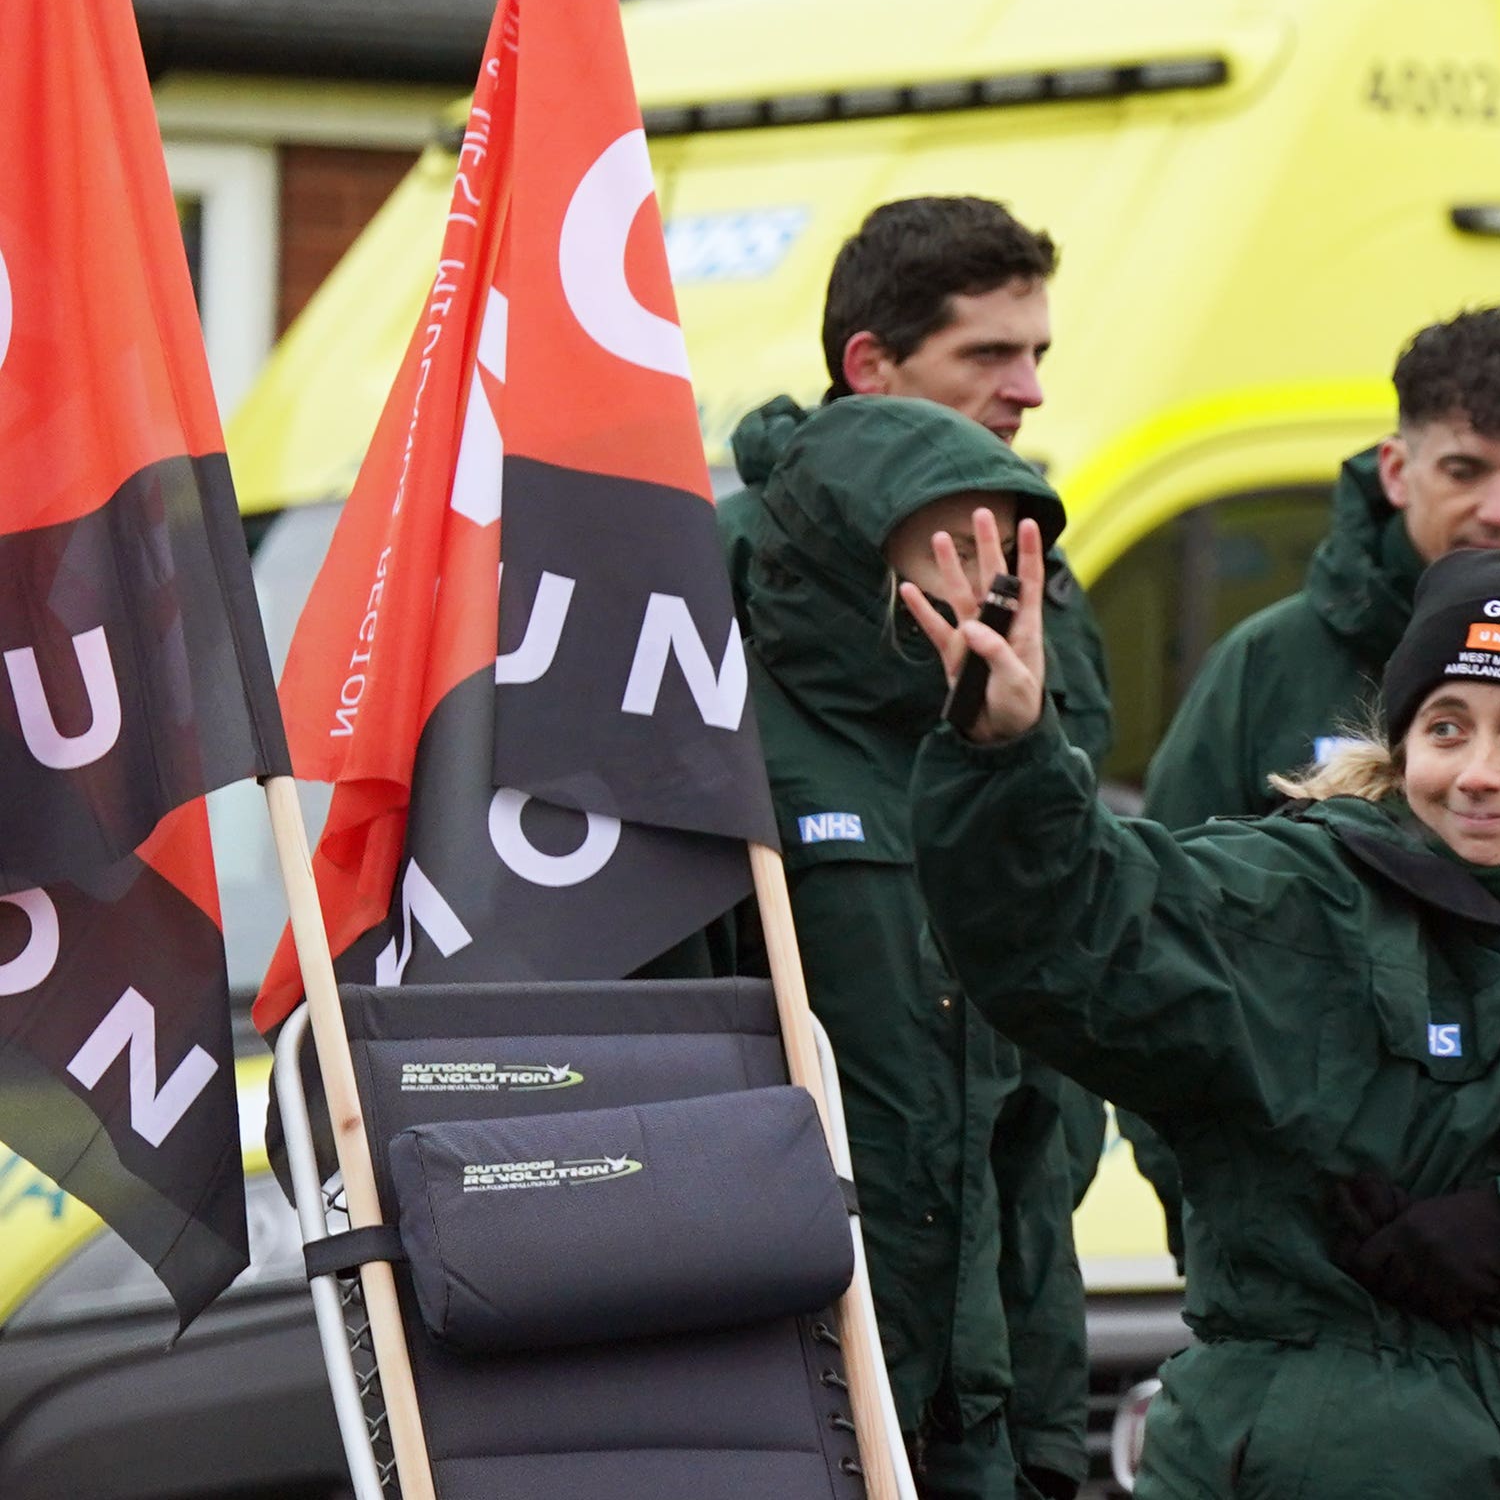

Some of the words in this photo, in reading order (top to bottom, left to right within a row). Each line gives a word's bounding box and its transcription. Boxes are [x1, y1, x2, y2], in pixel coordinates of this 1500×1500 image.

[1458, 651, 1492, 664] WEST
[804, 813, 861, 842] NHS
[402, 1062, 497, 1073] OUTDOOR
[401, 1072, 550, 1085] REVOLUTION
[463, 1160, 556, 1175] OUTDOOR
[463, 1164, 610, 1185] REVOLUTION
